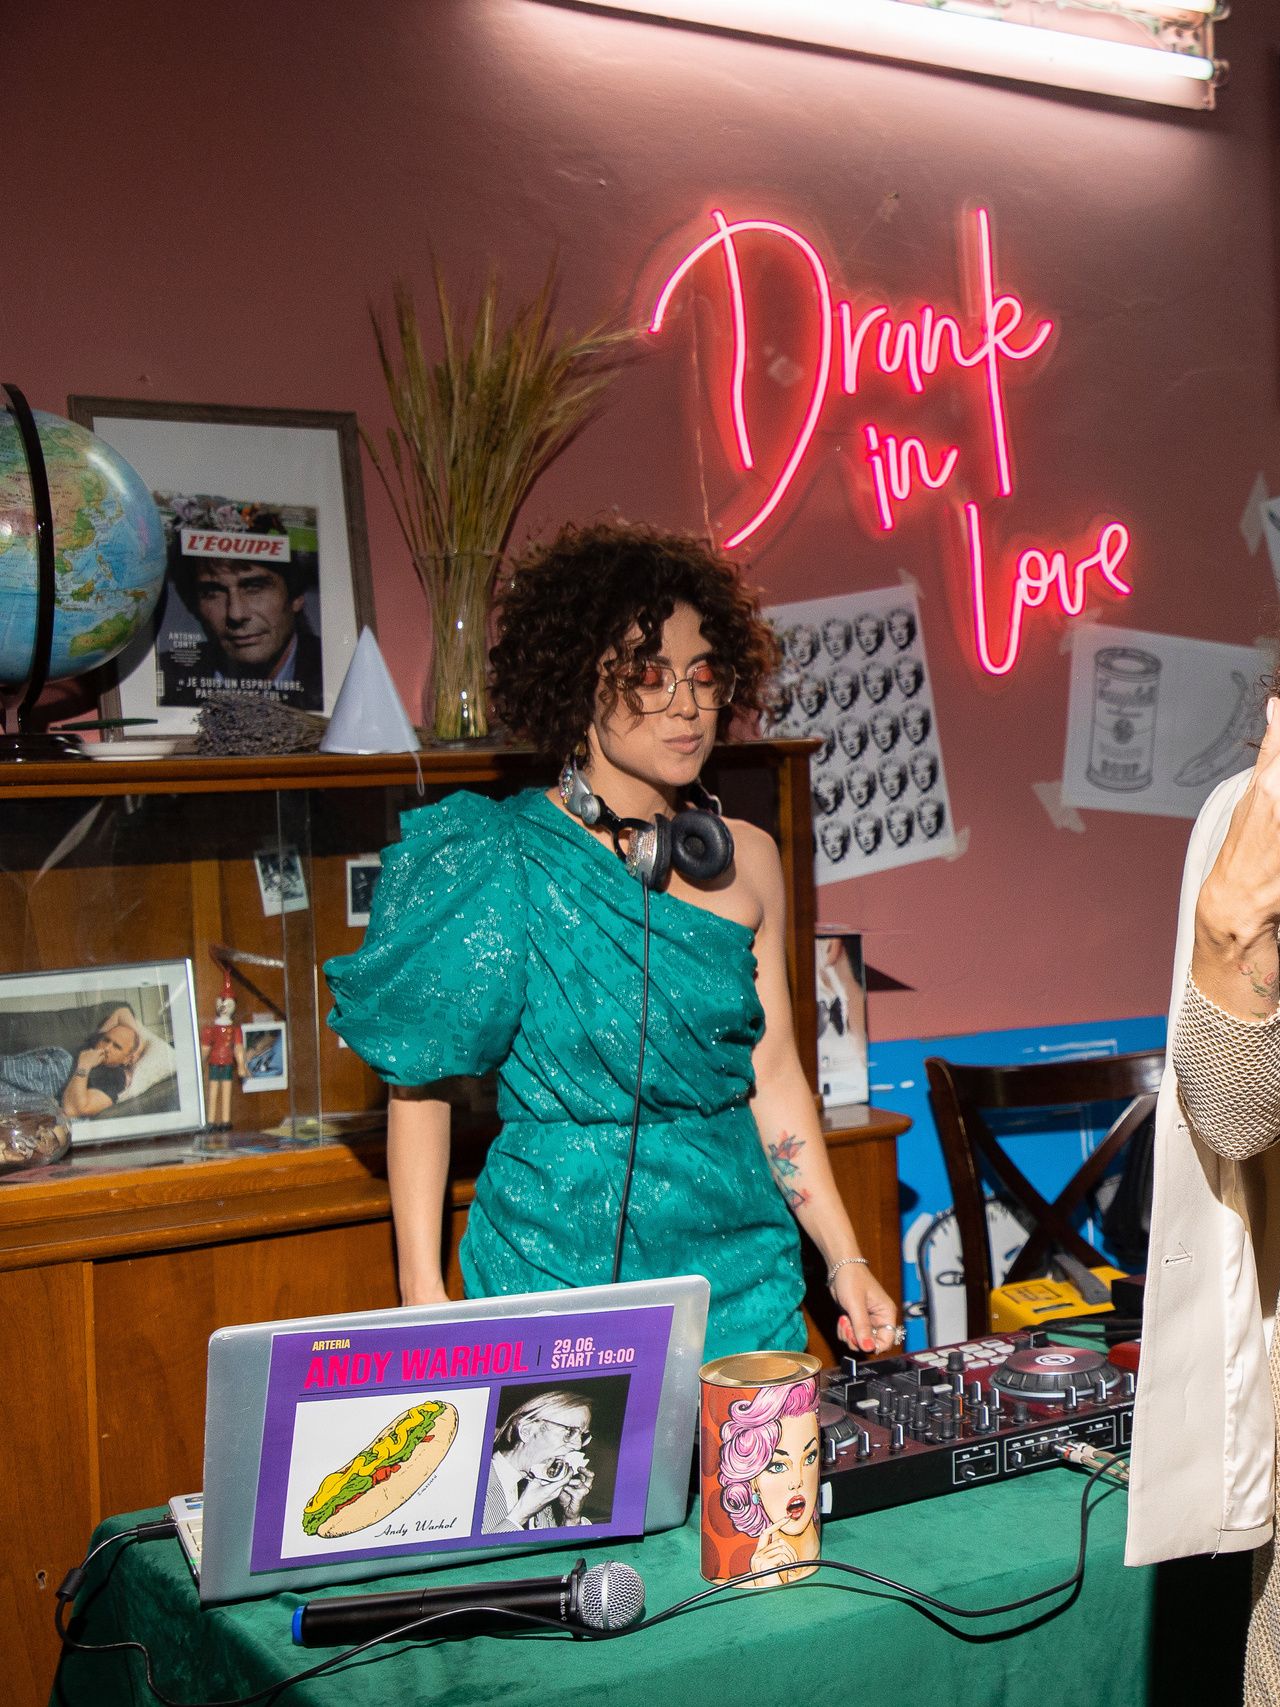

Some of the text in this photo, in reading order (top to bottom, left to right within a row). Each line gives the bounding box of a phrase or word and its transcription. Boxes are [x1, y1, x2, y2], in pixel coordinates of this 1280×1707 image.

[649, 208, 1053, 551] Drunk
[864, 423, 959, 531] in
[964, 501, 1133, 676] Love
[312, 1339, 351, 1351] ARTERIA
[551, 1348, 635, 1369] START 19:00
[553, 1337, 596, 1354] 29.06.
[303, 1341, 529, 1389] ANDY WARHOL
[374, 1516, 457, 1537] Andy Warhol
